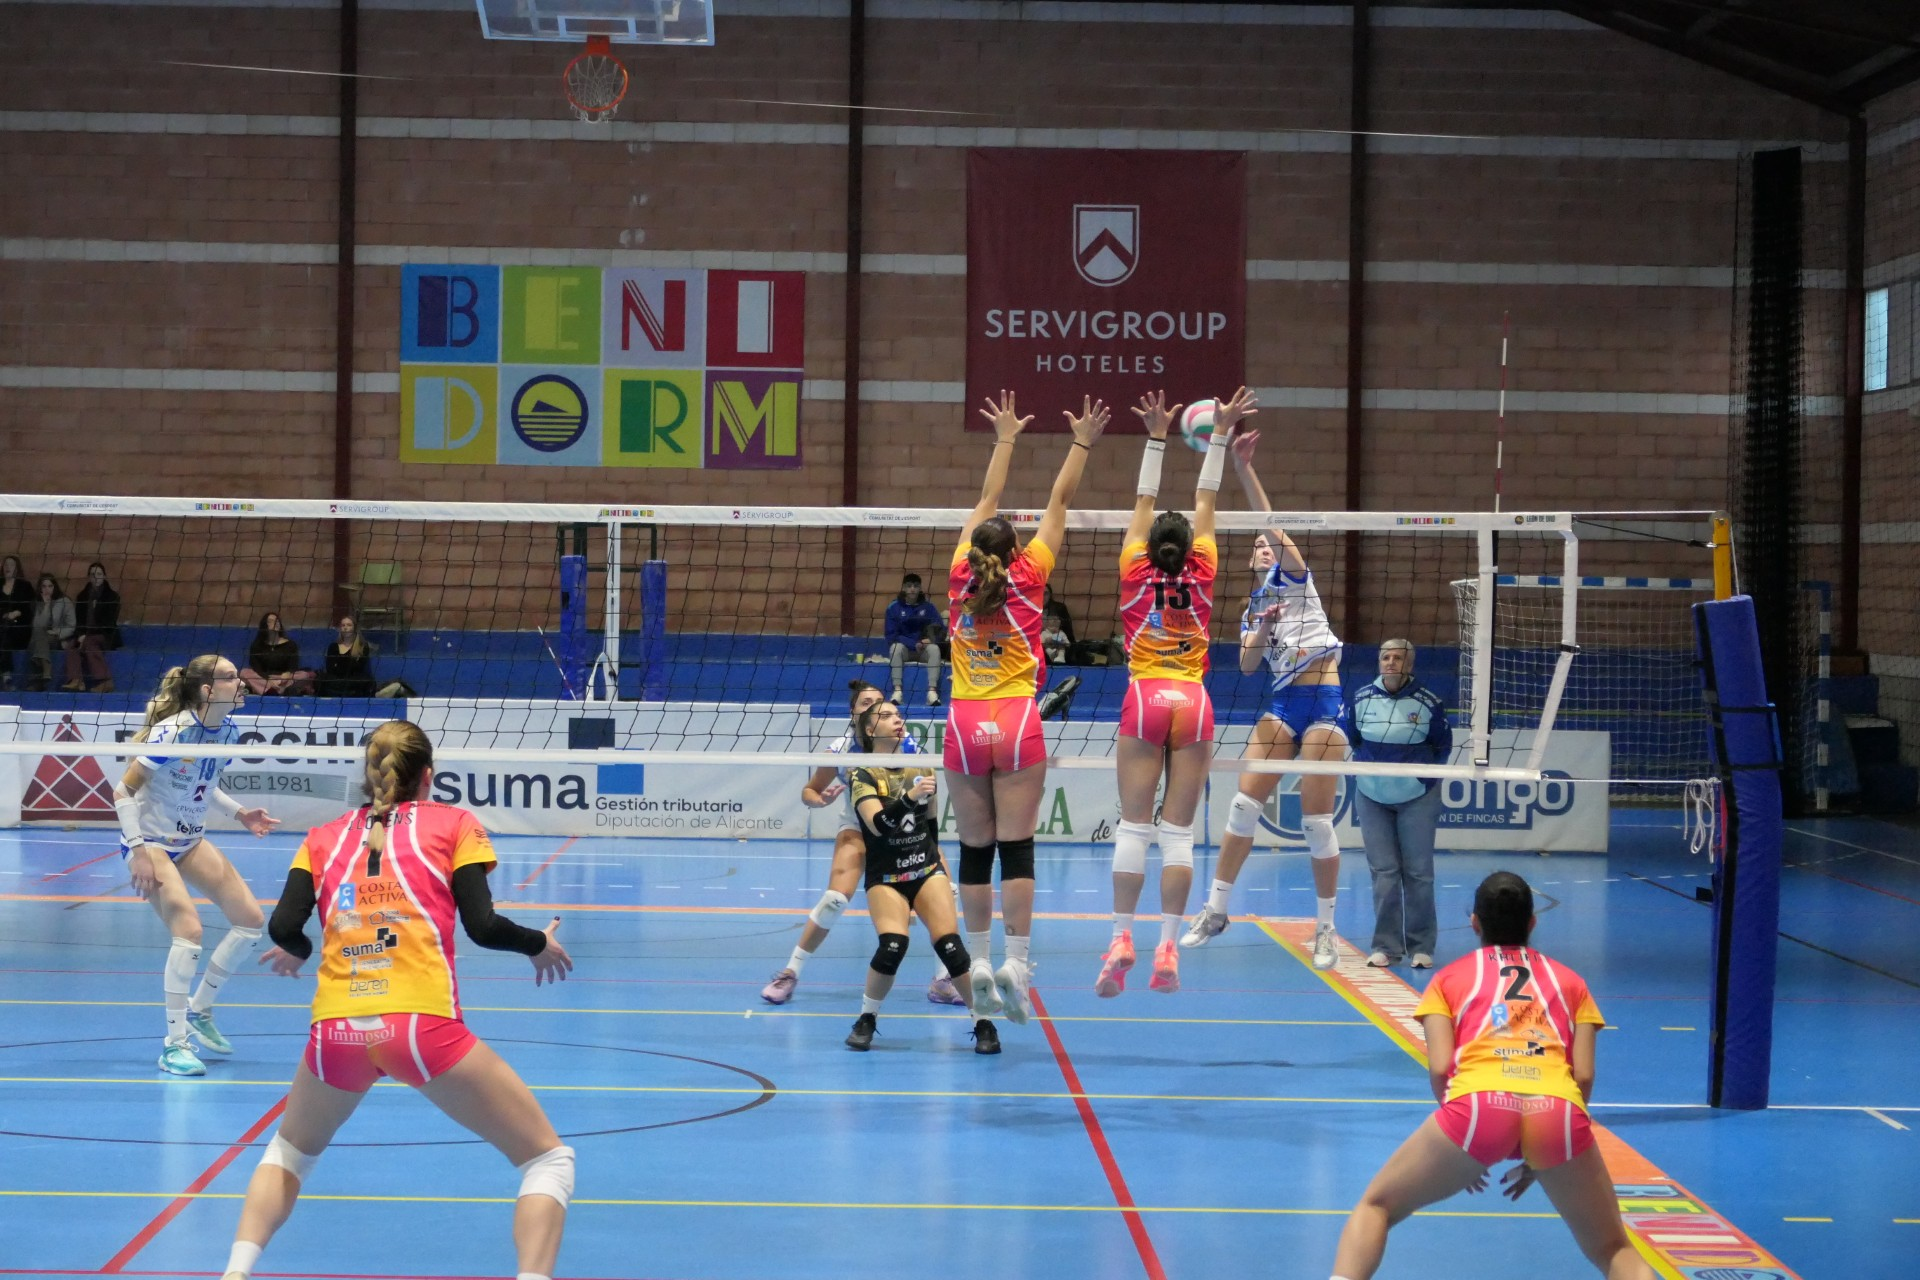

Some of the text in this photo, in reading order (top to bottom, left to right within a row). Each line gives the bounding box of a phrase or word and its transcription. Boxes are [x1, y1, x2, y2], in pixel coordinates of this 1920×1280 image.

[985, 309, 1227, 340] SERVIGROUP
[1036, 355, 1165, 374] HOTELES
[339, 505, 389, 513] SERVIGROUP
[742, 511, 793, 519] SERVIGROUP
[1154, 582, 1192, 610] 13
[966, 649, 993, 658] suma
[198, 757, 217, 781] 19
[267, 775, 313, 793] 1981
[432, 769, 589, 811] suma
[595, 796, 743, 813] Gestión tributaria
[595, 812, 784, 830] Diputación de Alicante
[1449, 813, 1464, 823] DE
[1466, 814, 1505, 824] FINCAS
[1091, 819, 1112, 842] de
[358, 881, 403, 894] COSTA
[358, 892, 409, 906] ACTIVA
[342, 942, 384, 957] suma
[350, 978, 389, 992] beren
[1499, 964, 1533, 1002] 2
[328, 1023, 396, 1042] Immosol
[1493, 1047, 1533, 1057] suma
[1486, 1092, 1554, 1109] Immosol
